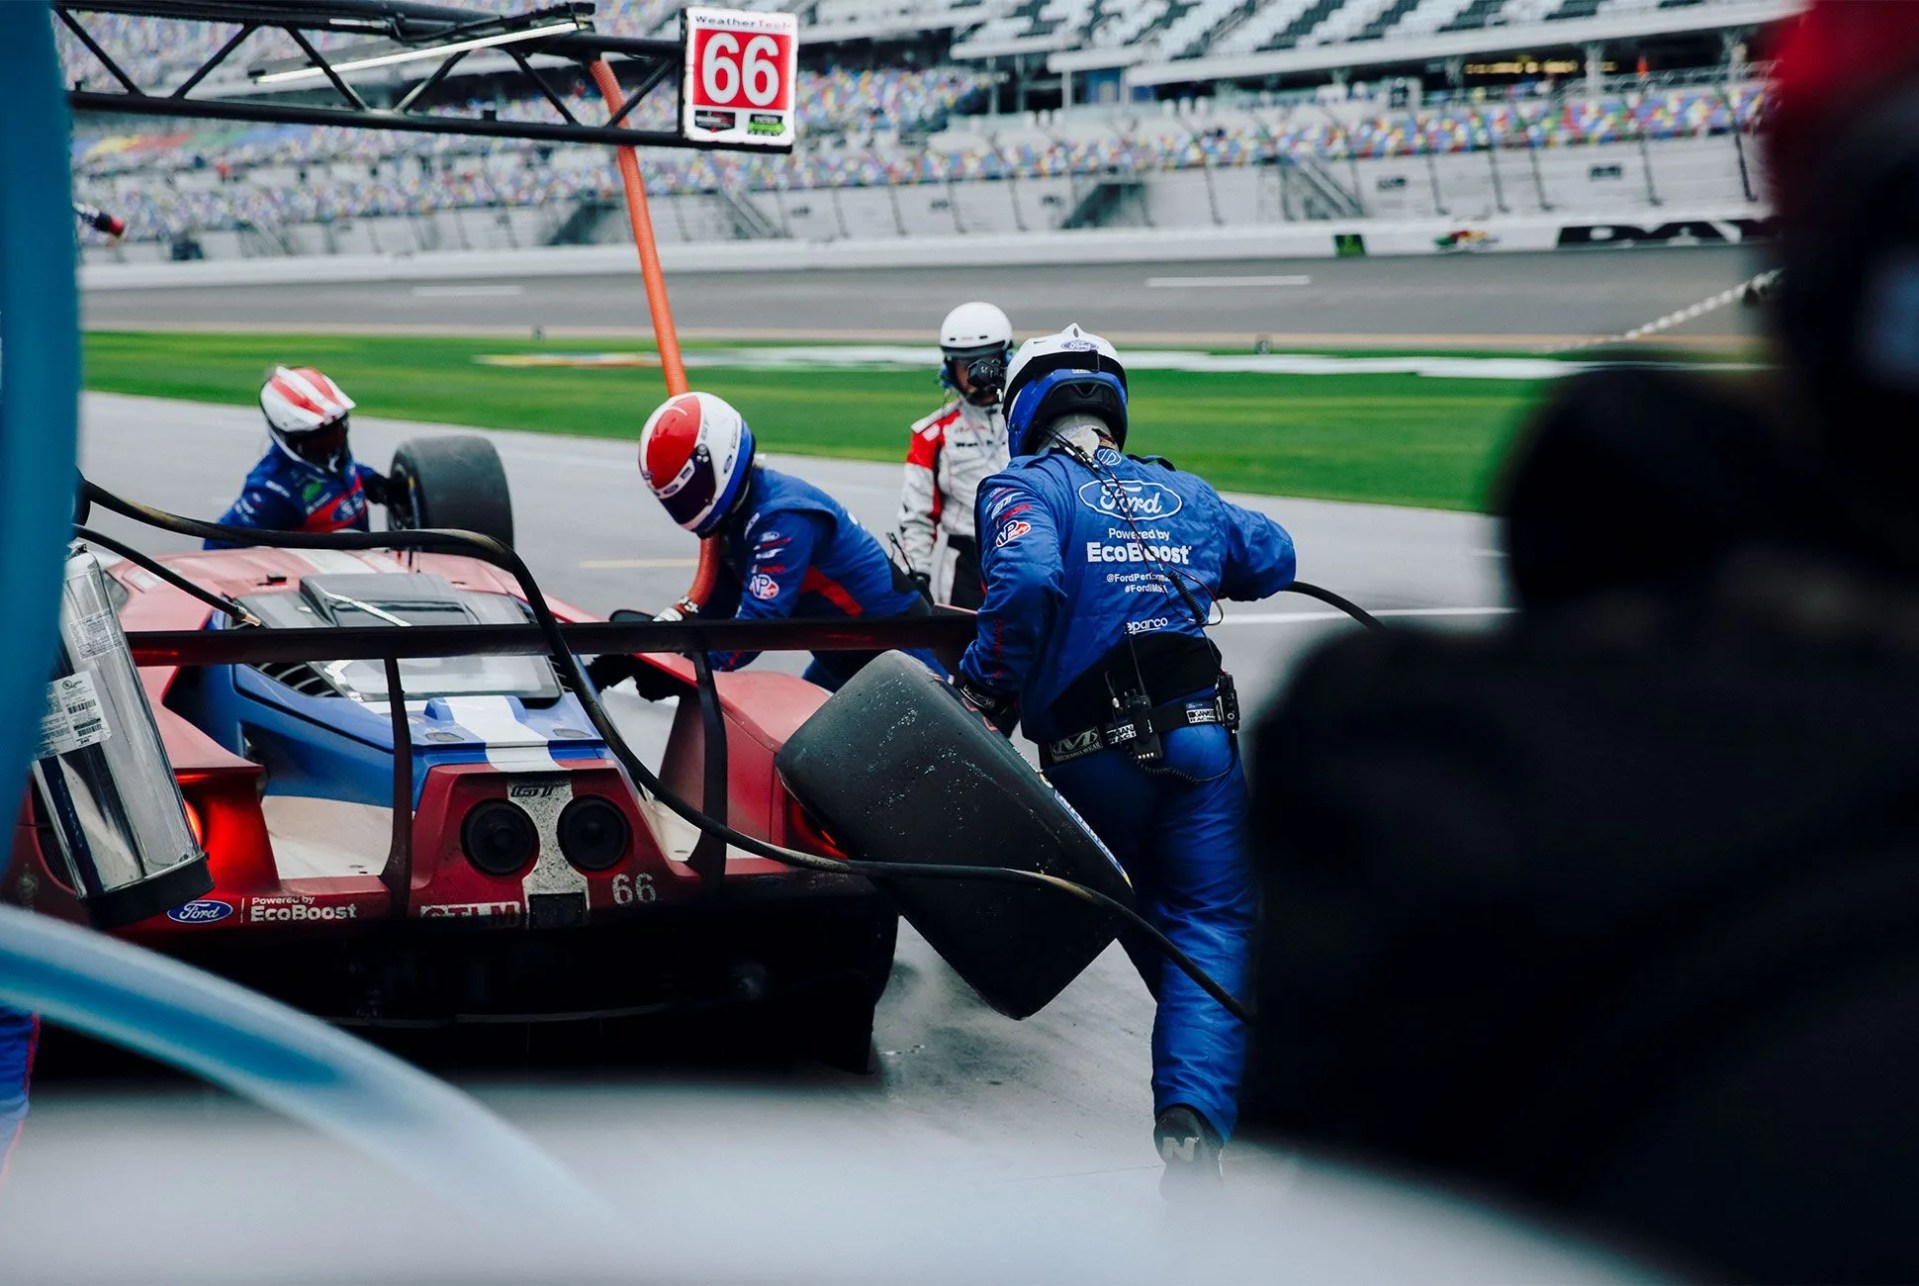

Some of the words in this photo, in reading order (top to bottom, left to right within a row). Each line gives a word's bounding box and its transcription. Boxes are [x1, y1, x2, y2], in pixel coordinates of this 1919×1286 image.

[702, 32, 779, 107] 66
[1100, 483, 1162, 513] Ford
[1108, 528, 1156, 540] Powered
[1156, 529, 1170, 541] by
[1086, 542, 1189, 565] EcoBoost
[612, 873, 656, 904] 66
[178, 903, 220, 919] Ford
[251, 896, 299, 905] Powered
[301, 896, 316, 905] by
[250, 903, 357, 922] EcoBoost
